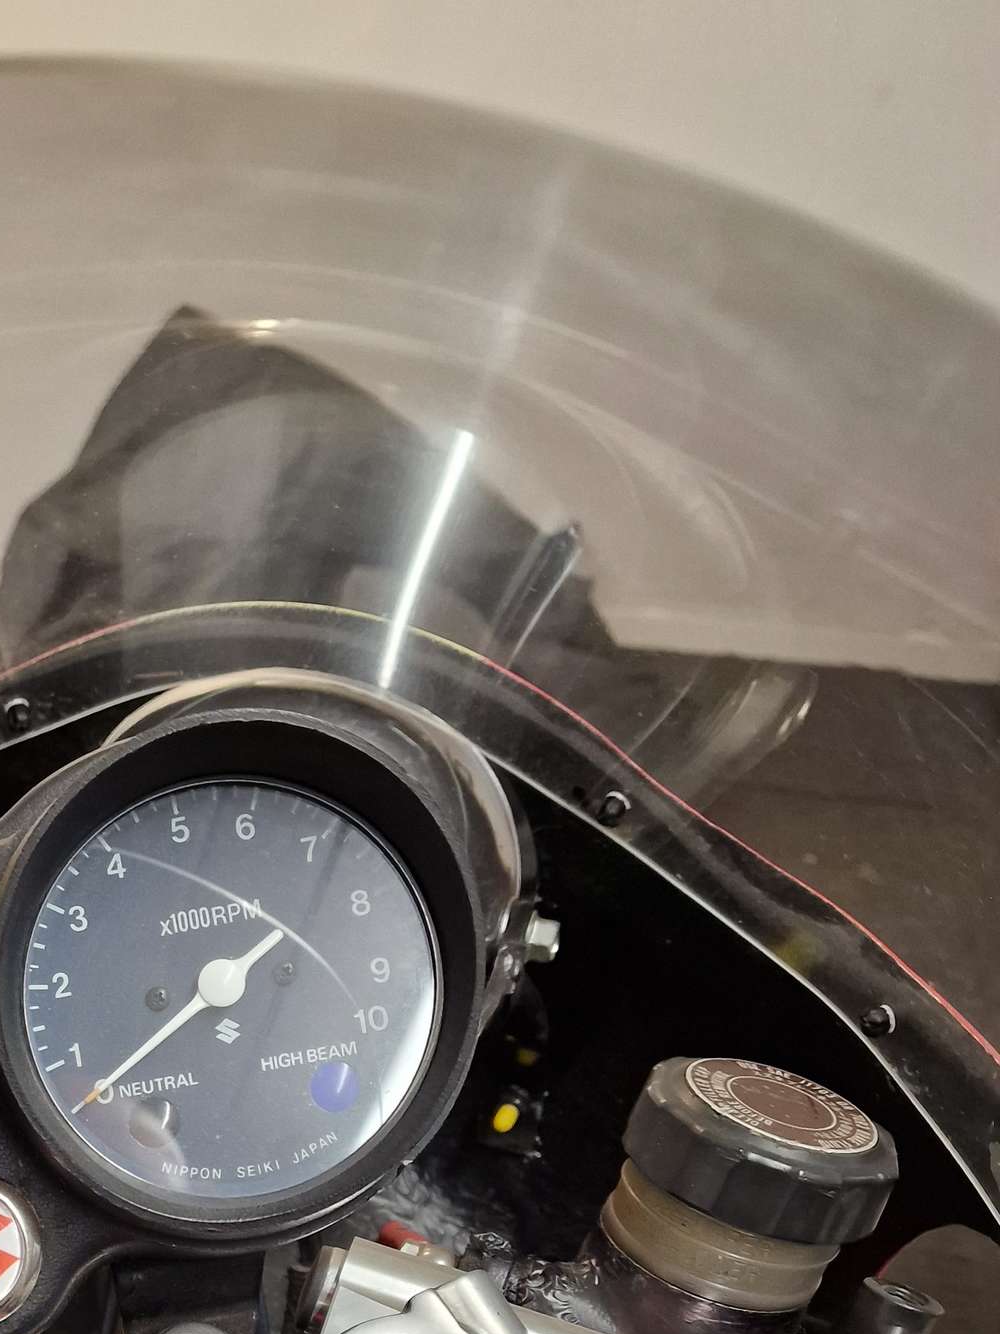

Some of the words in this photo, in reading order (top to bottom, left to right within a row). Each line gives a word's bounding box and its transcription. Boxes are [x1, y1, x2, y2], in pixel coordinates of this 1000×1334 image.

[171, 816, 190, 843] 5
[236, 814, 255, 840] 6
[300, 835, 317, 862] 7
[107, 854, 126, 879] 4
[351, 890, 370, 916] 8
[69, 906, 88, 931] 3
[371, 958, 390, 982] 9
[52, 973, 72, 999] 2
[354, 1006, 388, 1034] 10
[69, 1043, 82, 1067] 1
[260, 1051, 303, 1072] HIGH
[306, 1040, 358, 1063] BEAM
[119, 1073, 199, 1098] NEUTRAL
[162, 1162, 222, 1179] NIPPON
[237, 1161, 280, 1178] SEIKI
[292, 1132, 337, 1164] JAPAN
